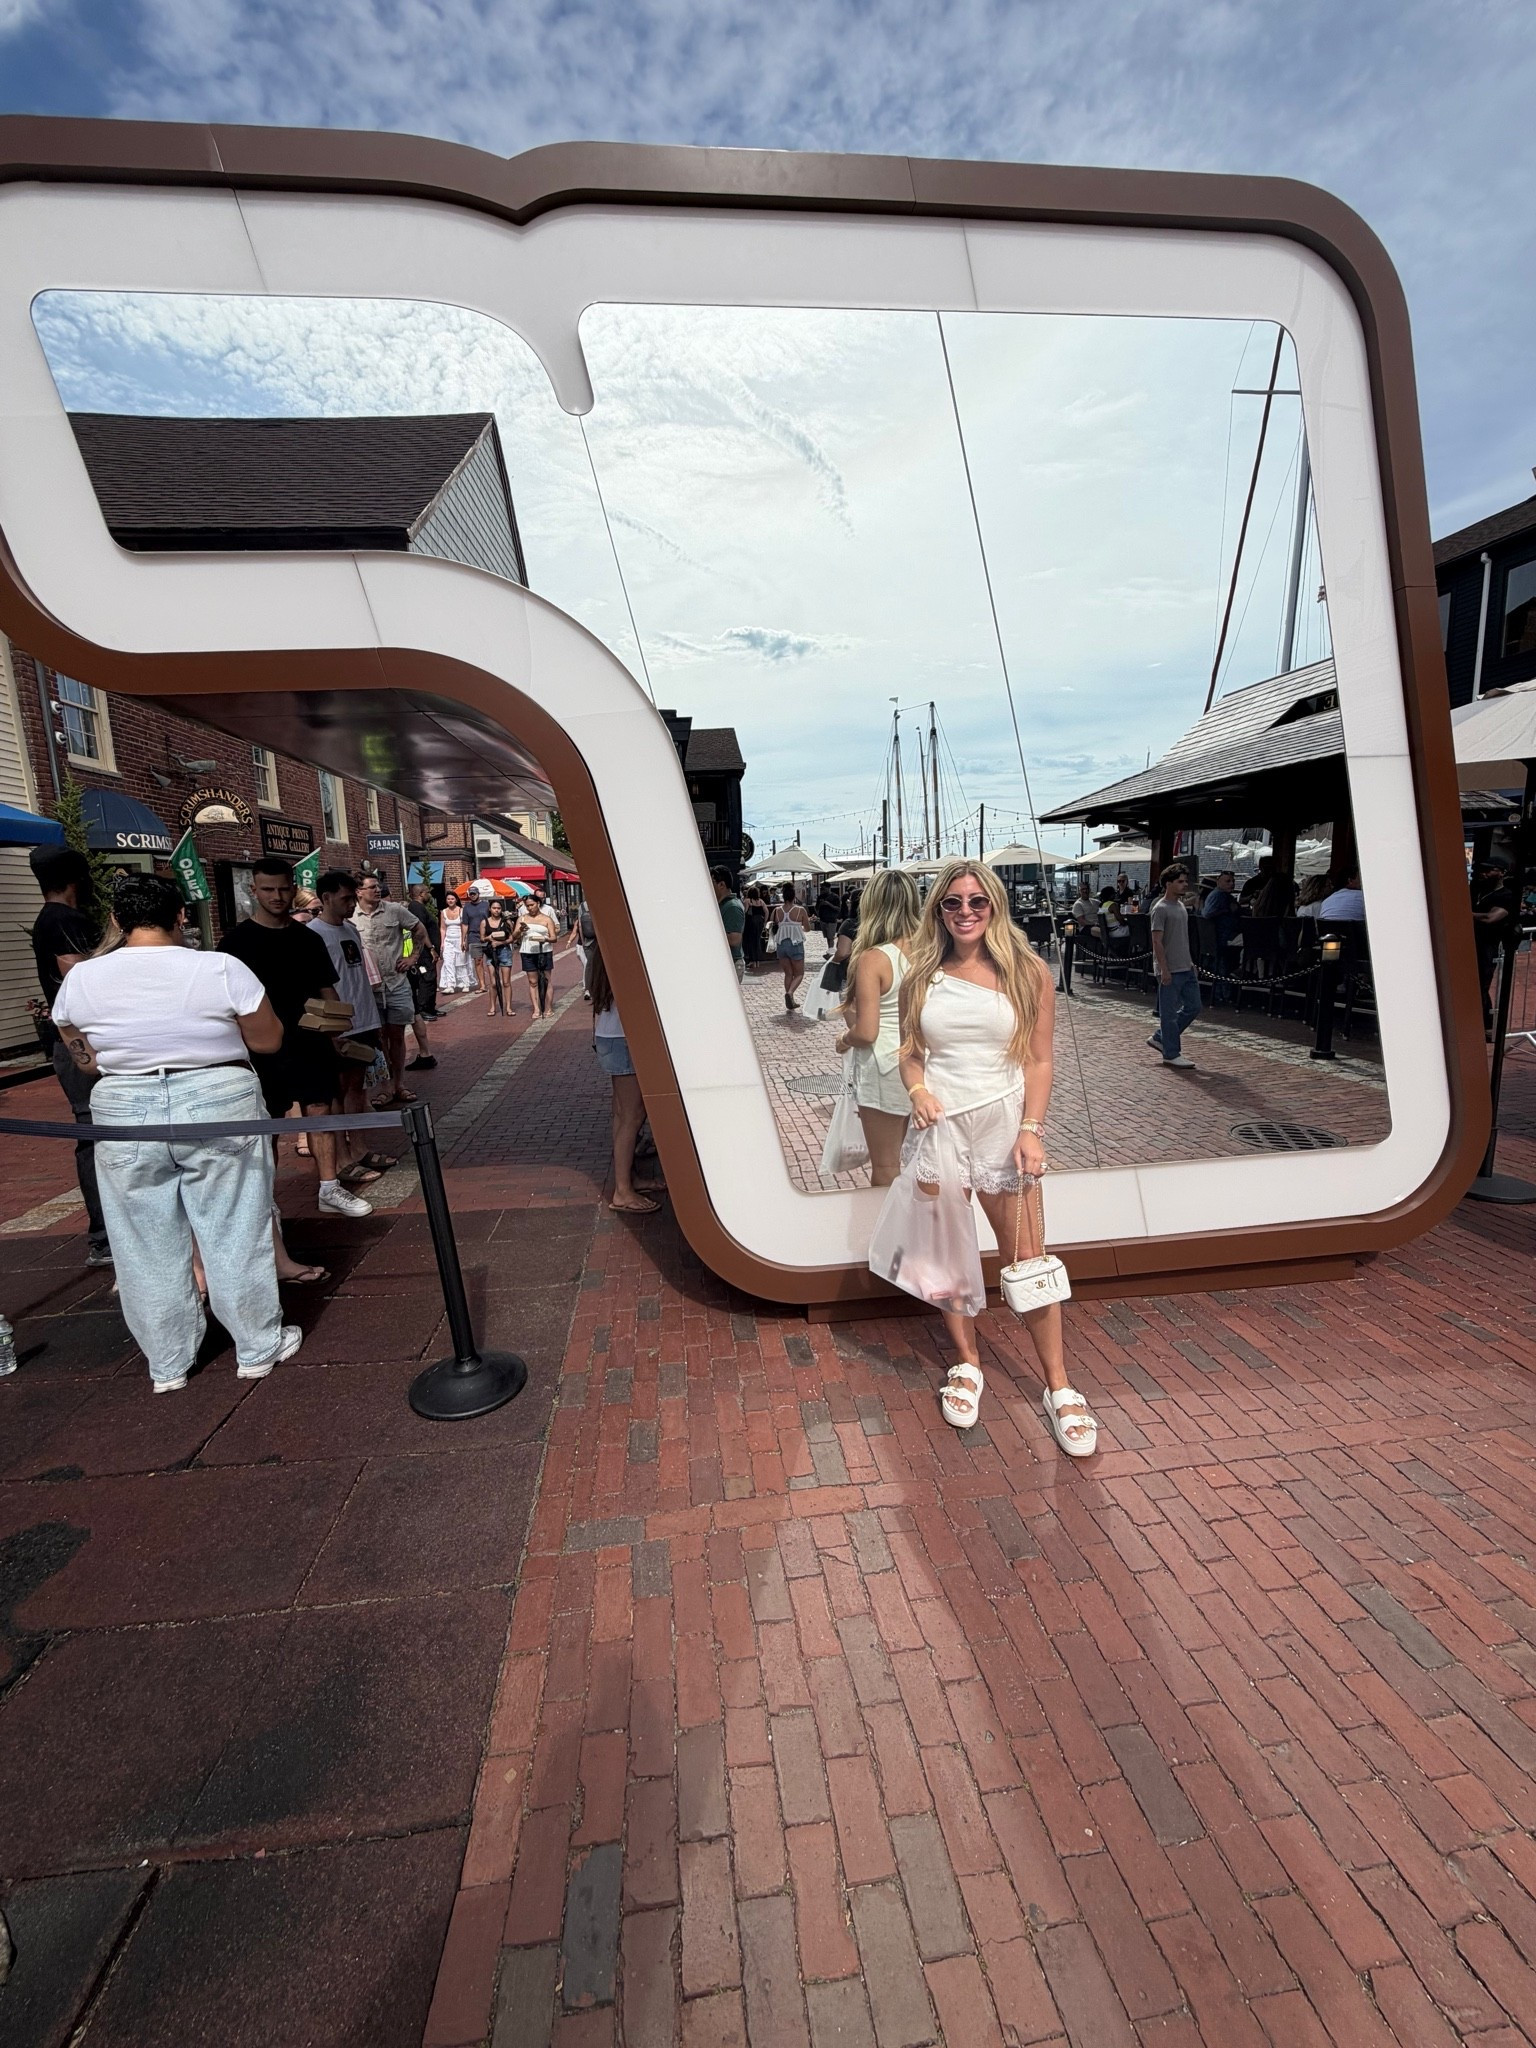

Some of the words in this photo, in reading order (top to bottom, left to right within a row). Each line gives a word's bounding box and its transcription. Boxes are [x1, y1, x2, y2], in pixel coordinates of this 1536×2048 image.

[180, 788, 253, 826] SCRIMSHANDERS
[266, 823, 290, 838] ANTIQUE
[291, 828, 309, 840] PRINTS
[272, 838, 288, 851] MAPS
[288, 840, 310, 853] GALLERY
[369, 840, 381, 850] SEA
[382, 839, 400, 849] BAGS
[179, 858, 205, 901] OPEN
[302, 869, 313, 887] OP
